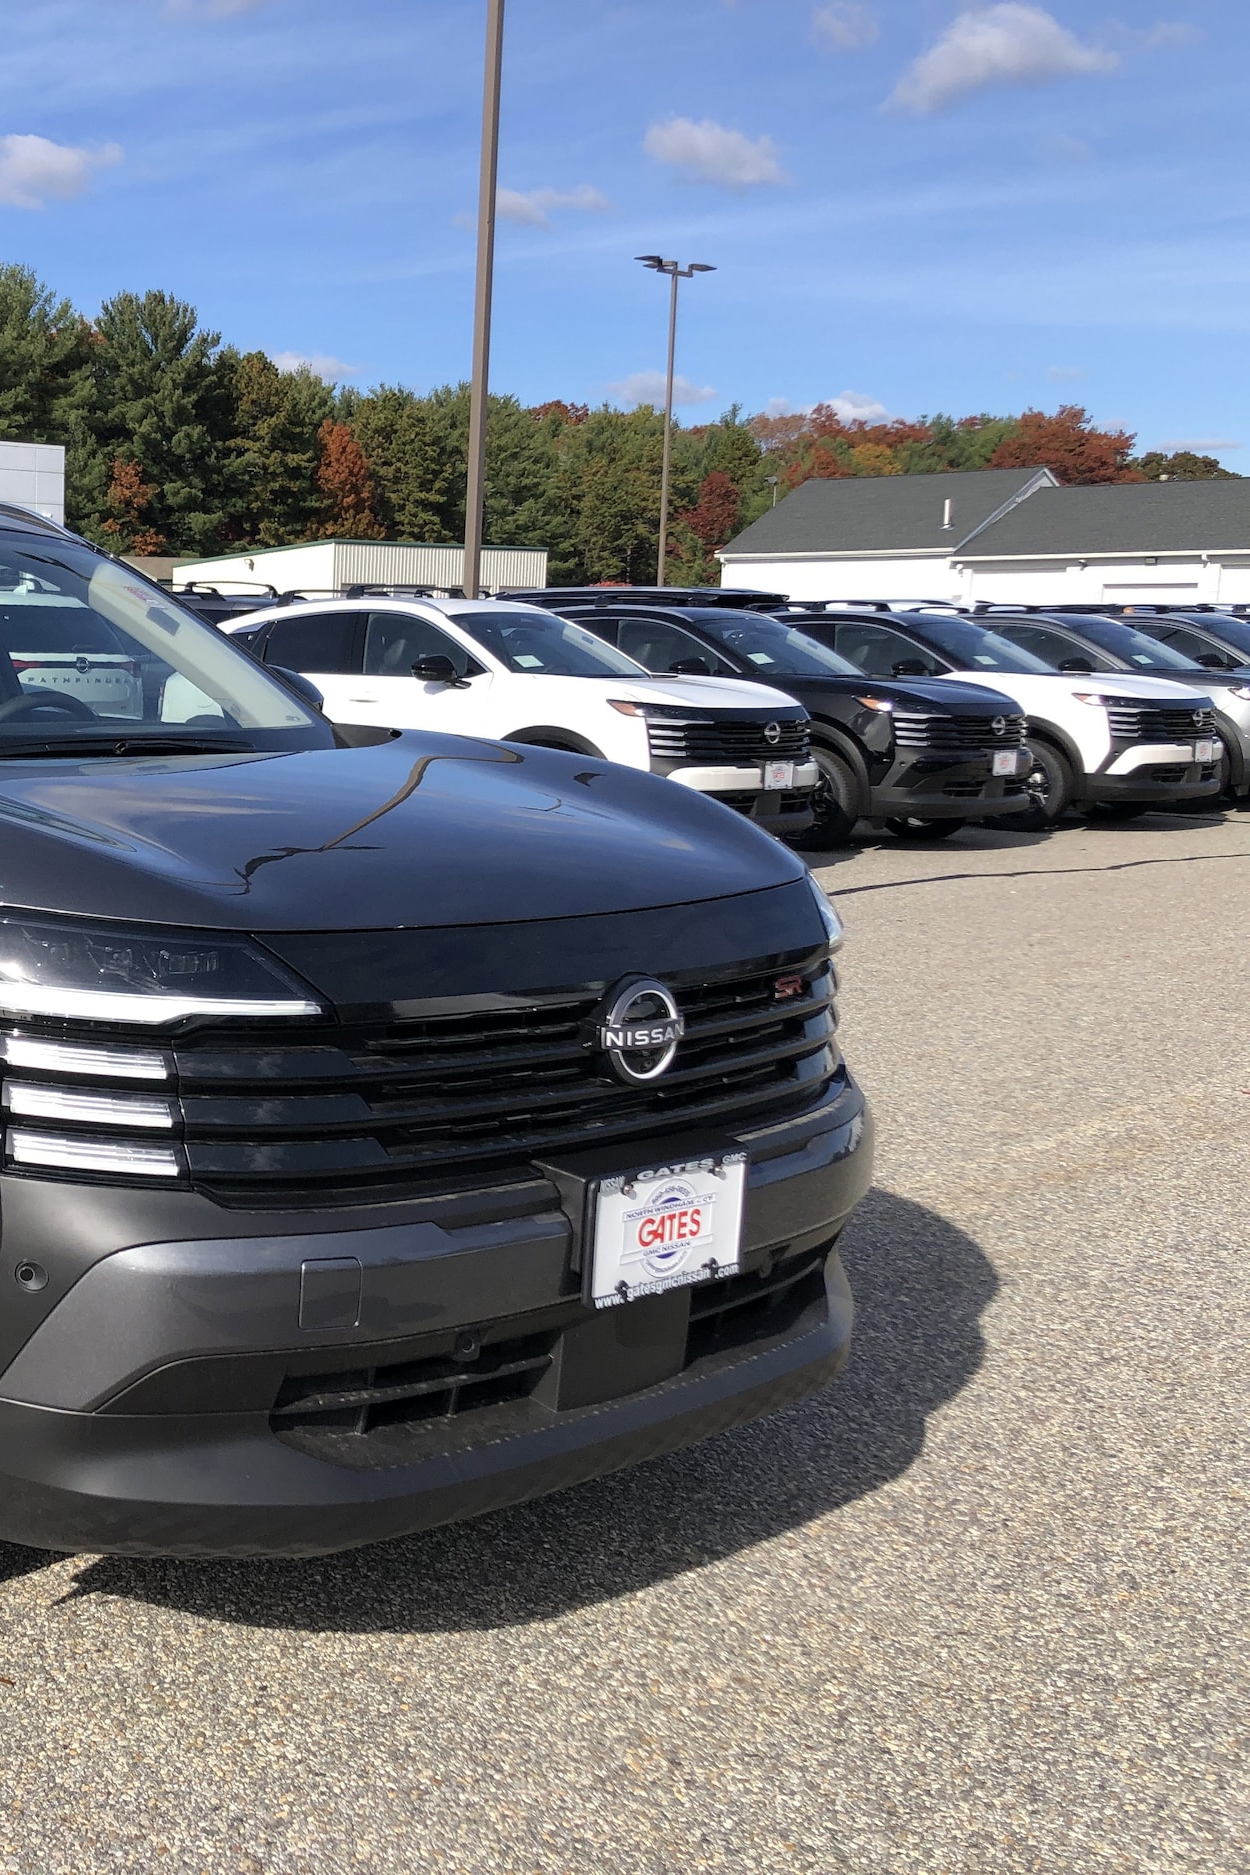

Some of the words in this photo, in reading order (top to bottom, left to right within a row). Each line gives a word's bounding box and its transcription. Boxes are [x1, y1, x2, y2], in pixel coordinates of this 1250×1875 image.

[775, 974, 804, 999] SR
[606, 1022, 684, 1047] NISSAN
[636, 1157, 715, 1180] GATES
[722, 1152, 748, 1165] GMC
[625, 1207, 654, 1219] NORTH
[638, 1208, 701, 1248] GATES
[642, 1247, 661, 1257] GMC
[661, 1240, 691, 1251] NISSAN
